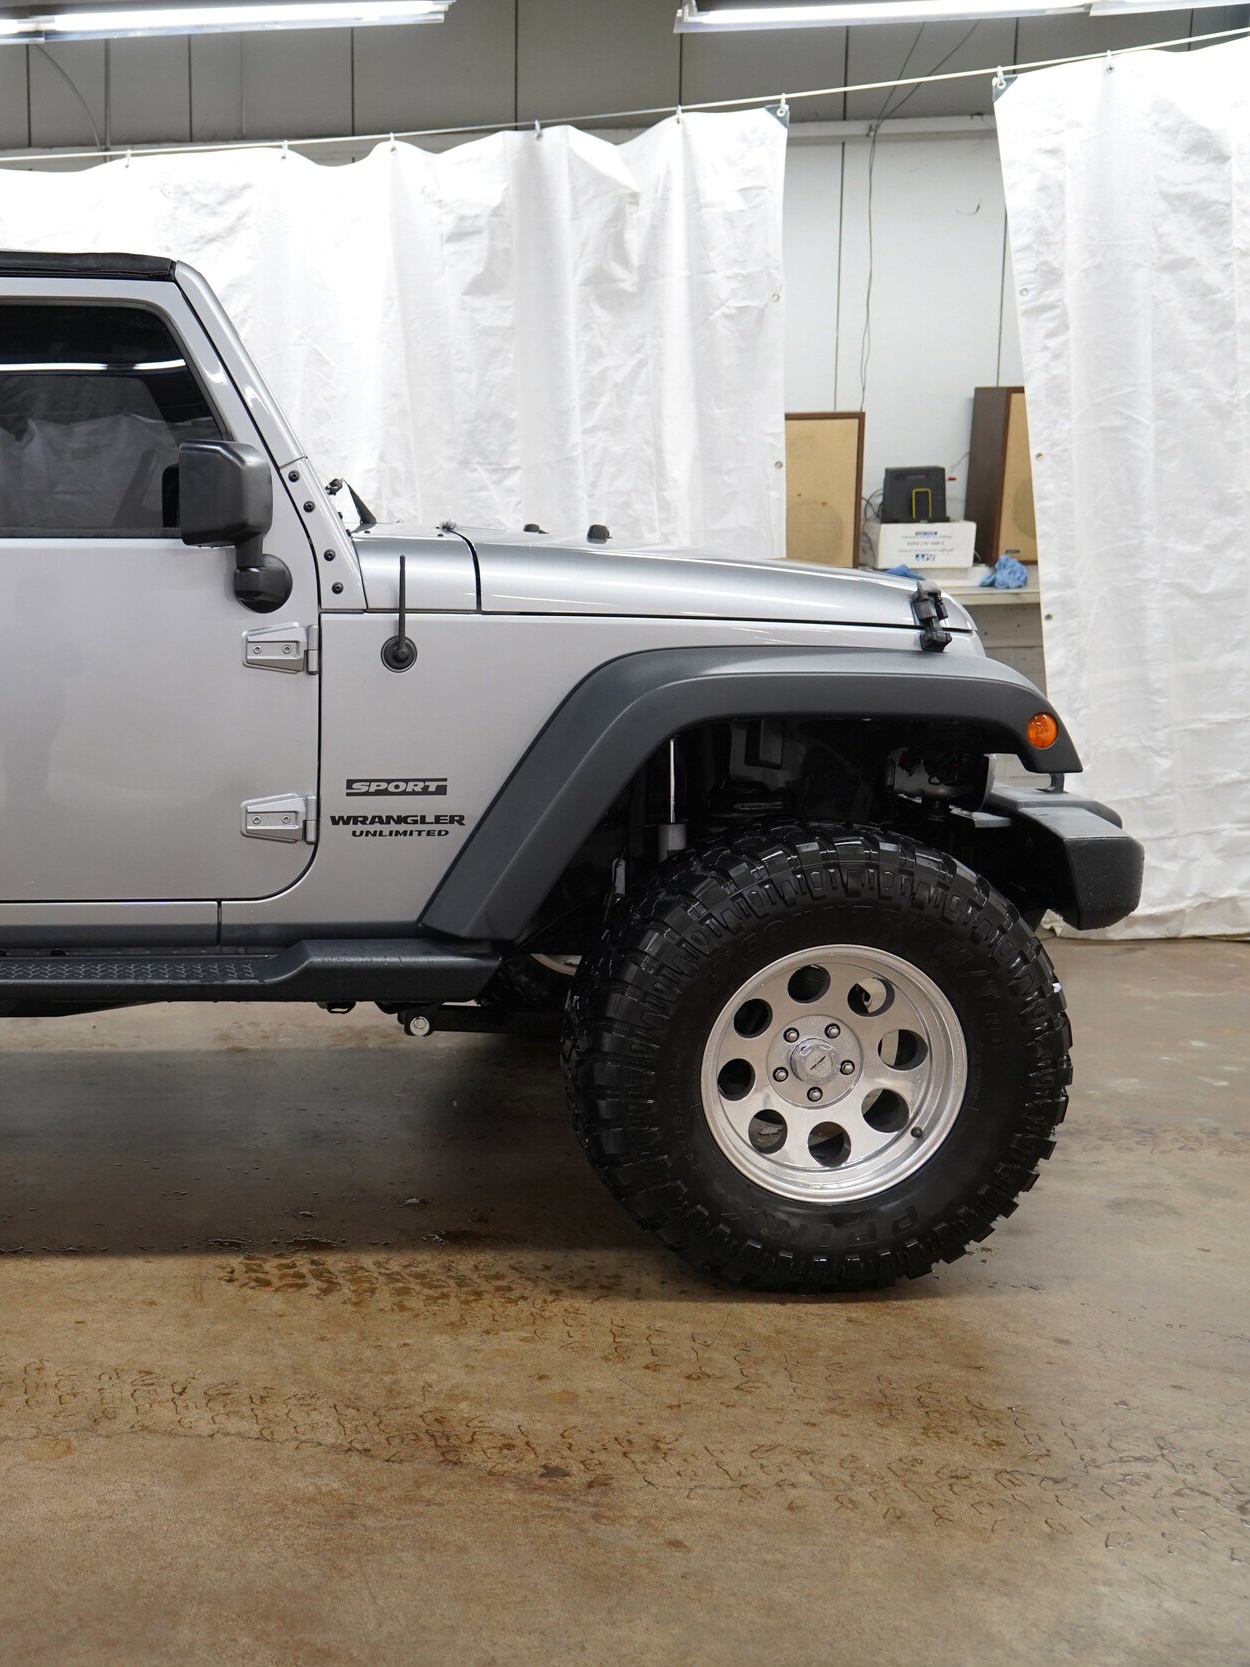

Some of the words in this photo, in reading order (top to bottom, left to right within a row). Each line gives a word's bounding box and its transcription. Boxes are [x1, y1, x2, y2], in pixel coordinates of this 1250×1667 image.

[348, 780, 447, 794] SPORT
[329, 814, 466, 826] WRANGLER
[351, 829, 450, 837] UNLIMITED
